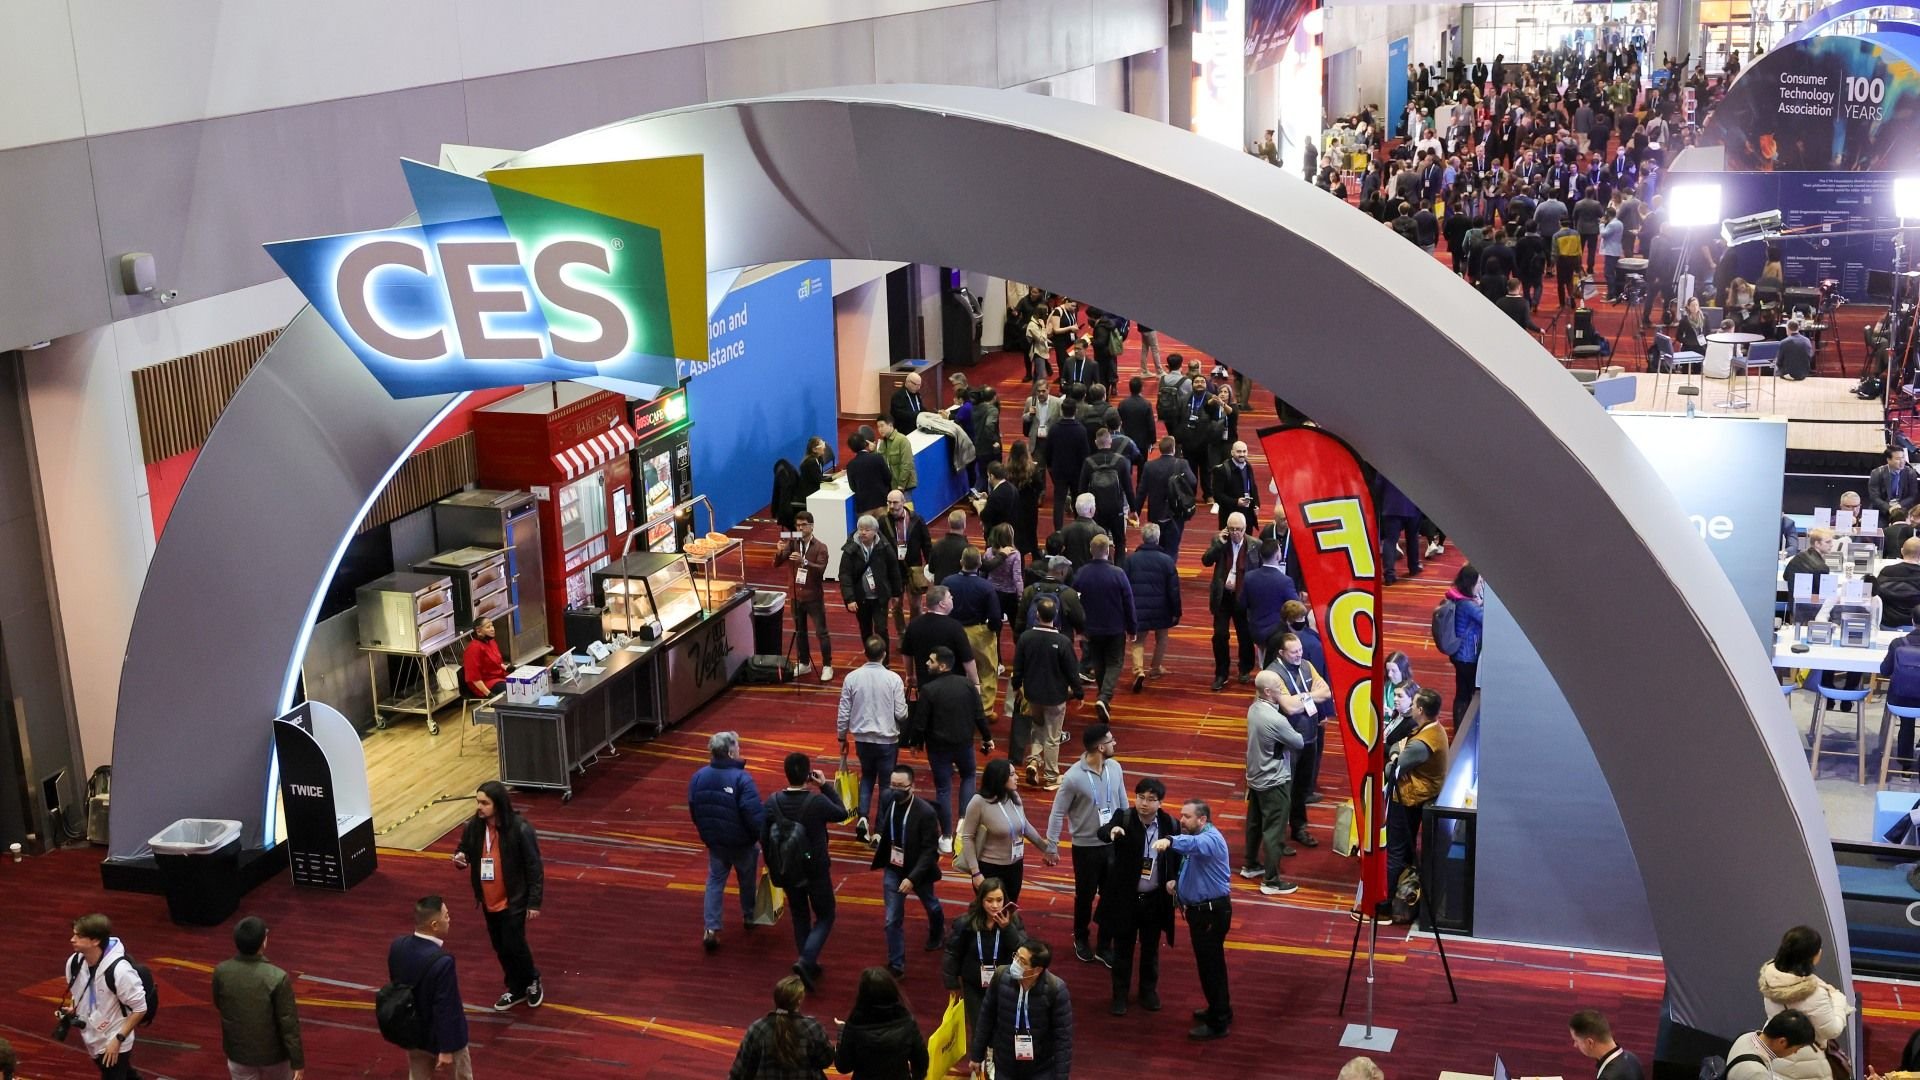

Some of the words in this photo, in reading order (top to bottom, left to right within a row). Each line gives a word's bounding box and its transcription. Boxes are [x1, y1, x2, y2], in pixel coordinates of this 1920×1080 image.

[1780, 72, 1828, 86] Consumer
[1779, 87, 1835, 105] Technology
[1845, 76, 1886, 104] 100
[1778, 102, 1833, 117] Association
[1844, 103, 1884, 121] YEARS
[336, 239, 629, 363] CES
[708, 318, 726, 340] ion
[729, 302, 748, 332] and
[1688, 514, 1734, 540] ne
[290, 784, 324, 798] TWICE
